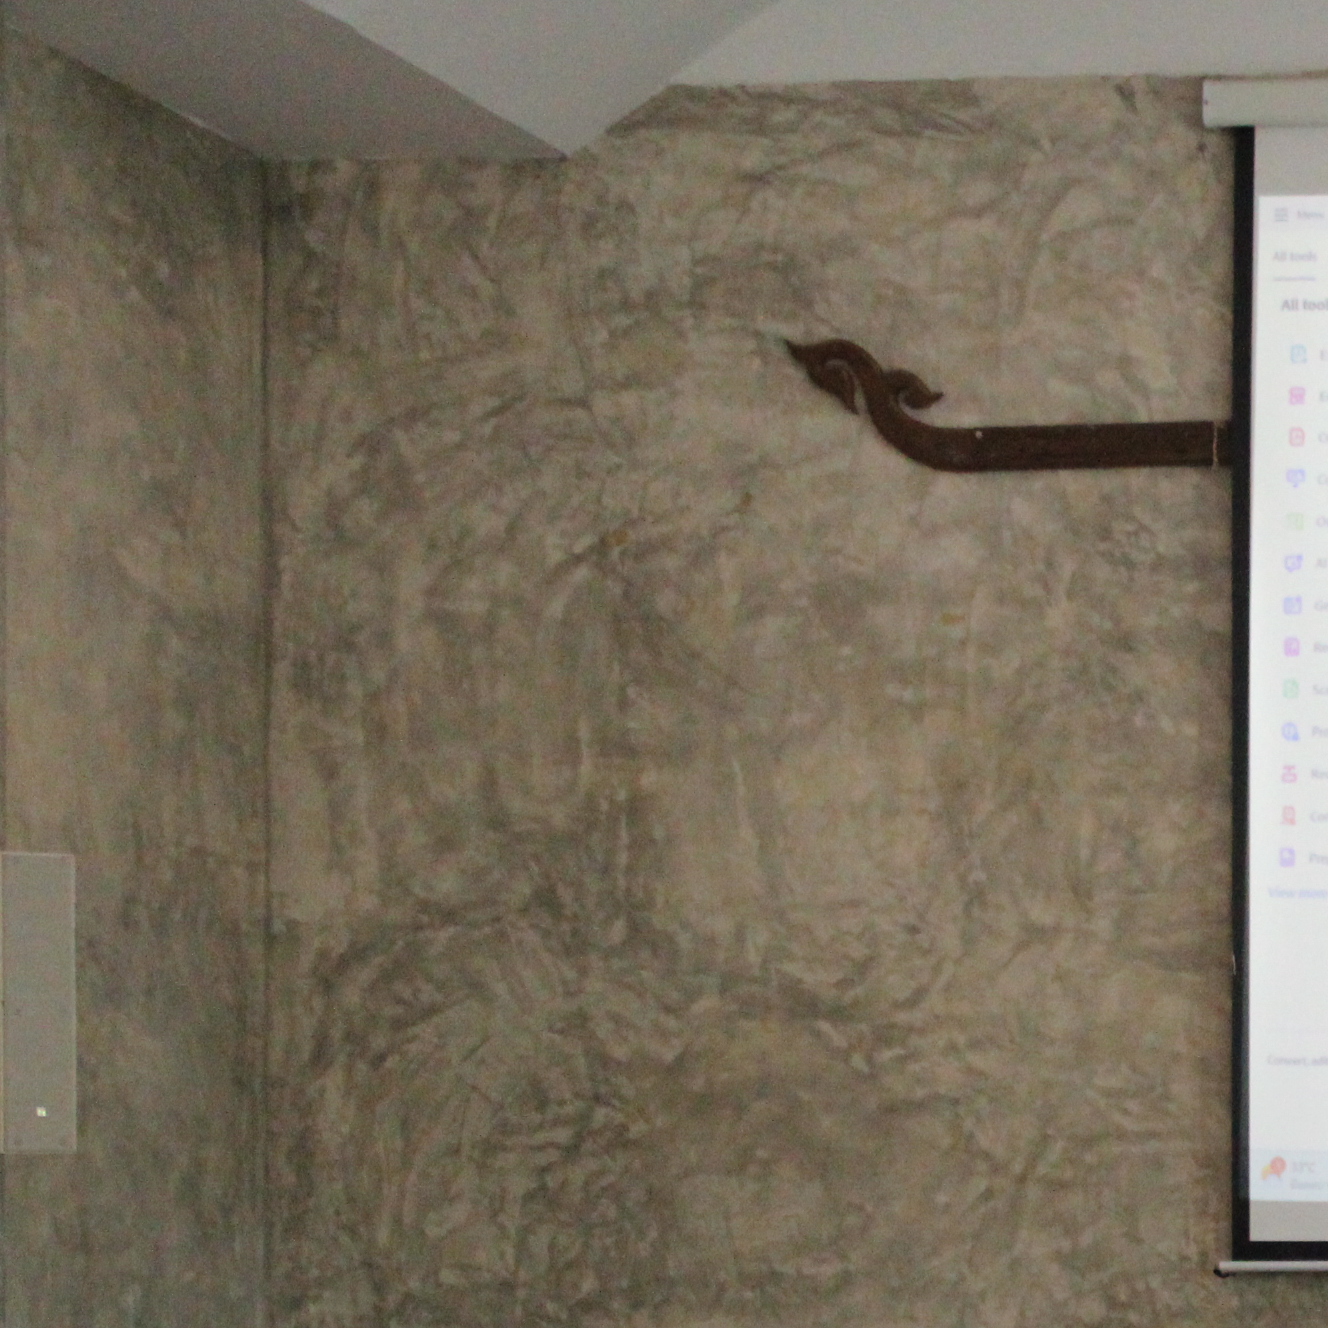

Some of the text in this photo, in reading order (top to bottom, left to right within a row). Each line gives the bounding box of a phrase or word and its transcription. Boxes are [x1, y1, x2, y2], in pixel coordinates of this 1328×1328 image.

[1273, 249, 1317, 262] All tools
[1281, 298, 1302, 312] All
